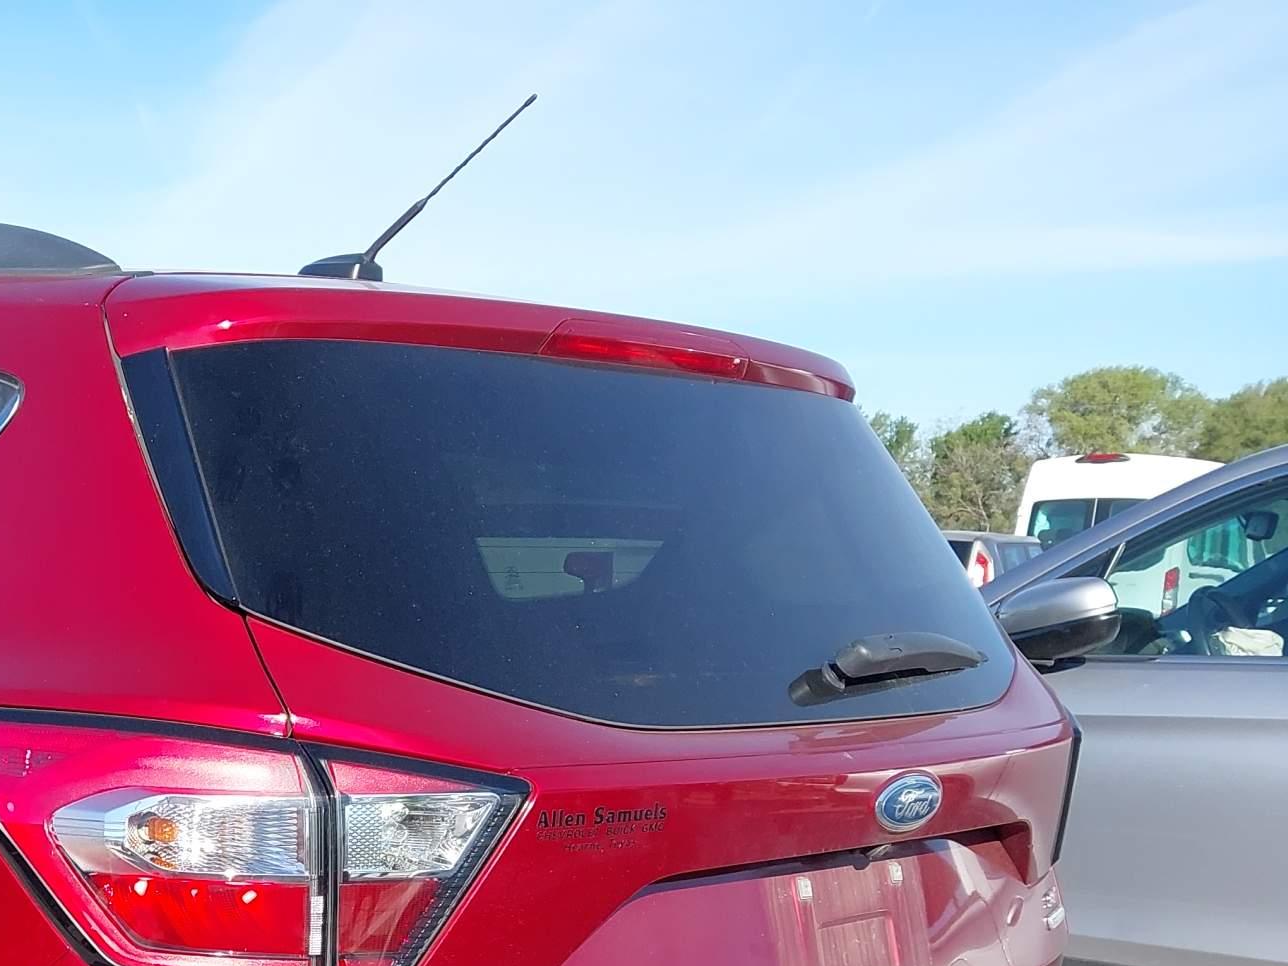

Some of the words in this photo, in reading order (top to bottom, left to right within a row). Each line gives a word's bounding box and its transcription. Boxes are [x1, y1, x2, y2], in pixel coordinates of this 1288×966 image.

[537, 809, 585, 828] Allen
[594, 802, 667, 825] Samuels
[894, 788, 933, 820] Ford
[606, 824, 636, 836] BUICK
[641, 822, 665, 833] GMC
